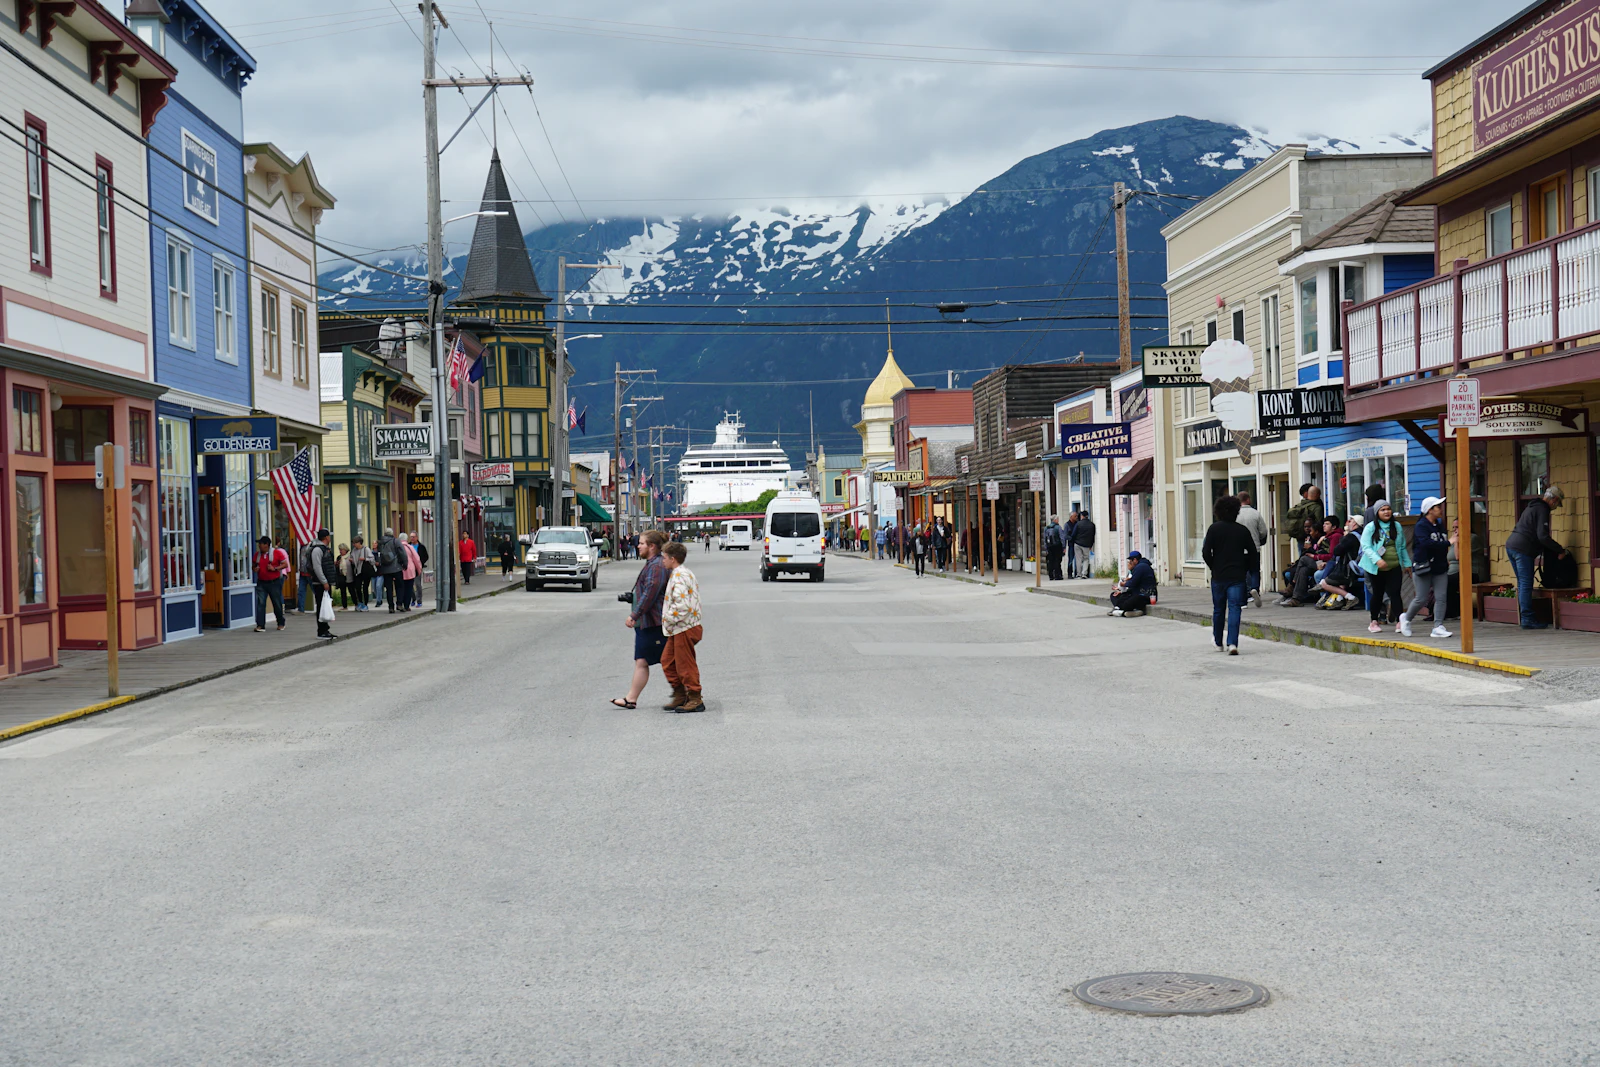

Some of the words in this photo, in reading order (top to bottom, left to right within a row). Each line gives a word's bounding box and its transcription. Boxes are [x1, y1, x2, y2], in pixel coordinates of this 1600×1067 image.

[1478, 36, 1559, 122] KLOTHES
[1563, 11, 1600, 76] RUS
[1485, 121, 1509, 142] SOUVENIRS
[1510, 113, 1523, 129] GIFTS
[1525, 103, 1545, 121] APPAREL
[1547, 87, 1575, 111] FOOTWEAR
[1578, 73, 1600, 94] OUTERW
[1152, 350, 1204, 359] SKAGW
[1152, 358, 1201, 366] JEWEL
[1158, 375, 1203, 384] PANDOR
[1458, 384, 1468, 393] 20
[1261, 391, 1295, 417] KONE
[1300, 390, 1345, 414] KOMPA
[1453, 394, 1473, 402] MINUTE
[1451, 403, 1476, 411] PARKING
[1480, 402, 1526, 417] OTHES
[1527, 402, 1564, 417] RUSH
[1273, 418, 1282, 427] ICE
[1284, 418, 1301, 427] CREAM
[1306, 416, 1322, 426] CANDY
[1329, 414, 1346, 424] FUDG
[1485, 420, 1543, 429] SOUVENIRS
[376, 429, 429, 446] SKAGWAY
[1068, 425, 1123, 445] CREATIVE
[1187, 426, 1221, 449] SKAGWAY
[203, 440, 243, 451] GOLDEN
[244, 439, 271, 450] BEAR
[1064, 434, 1129, 455] GOLDSMITH
[1102, 448, 1128, 456] ALASKA
[472, 463, 511, 481] HARDWARE
[882, 472, 922, 481] PANTHEON
